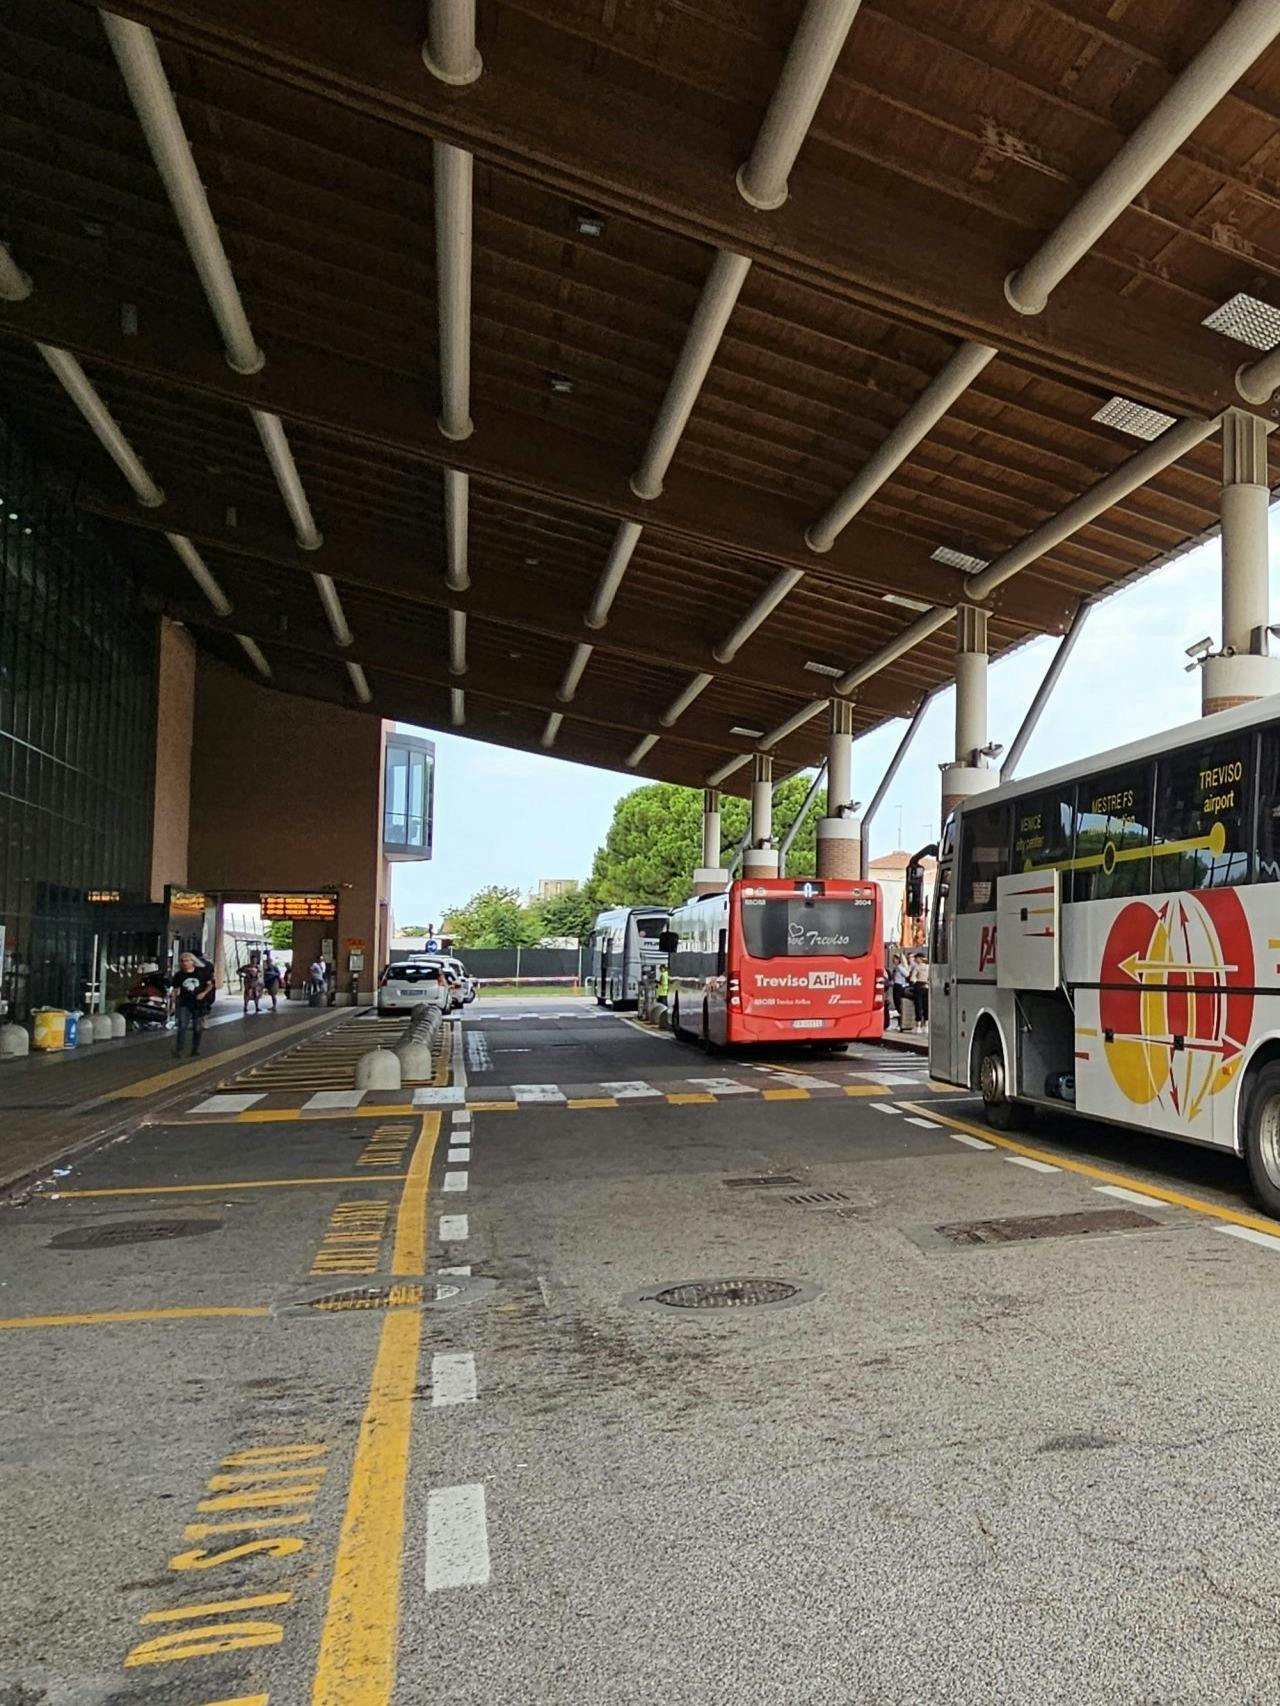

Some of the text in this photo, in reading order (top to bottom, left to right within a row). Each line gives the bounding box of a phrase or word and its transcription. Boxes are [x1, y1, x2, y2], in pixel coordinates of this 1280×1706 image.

[1200, 762, 1242, 790] TREVISO
[1092, 790, 1134, 813] MESTRE FS
[1204, 791, 1235, 815] airport
[806, 931, 850, 945] Treviso
[755, 973, 862, 987] Treviso Airlink
[167, 1443, 330, 1571] STATO
